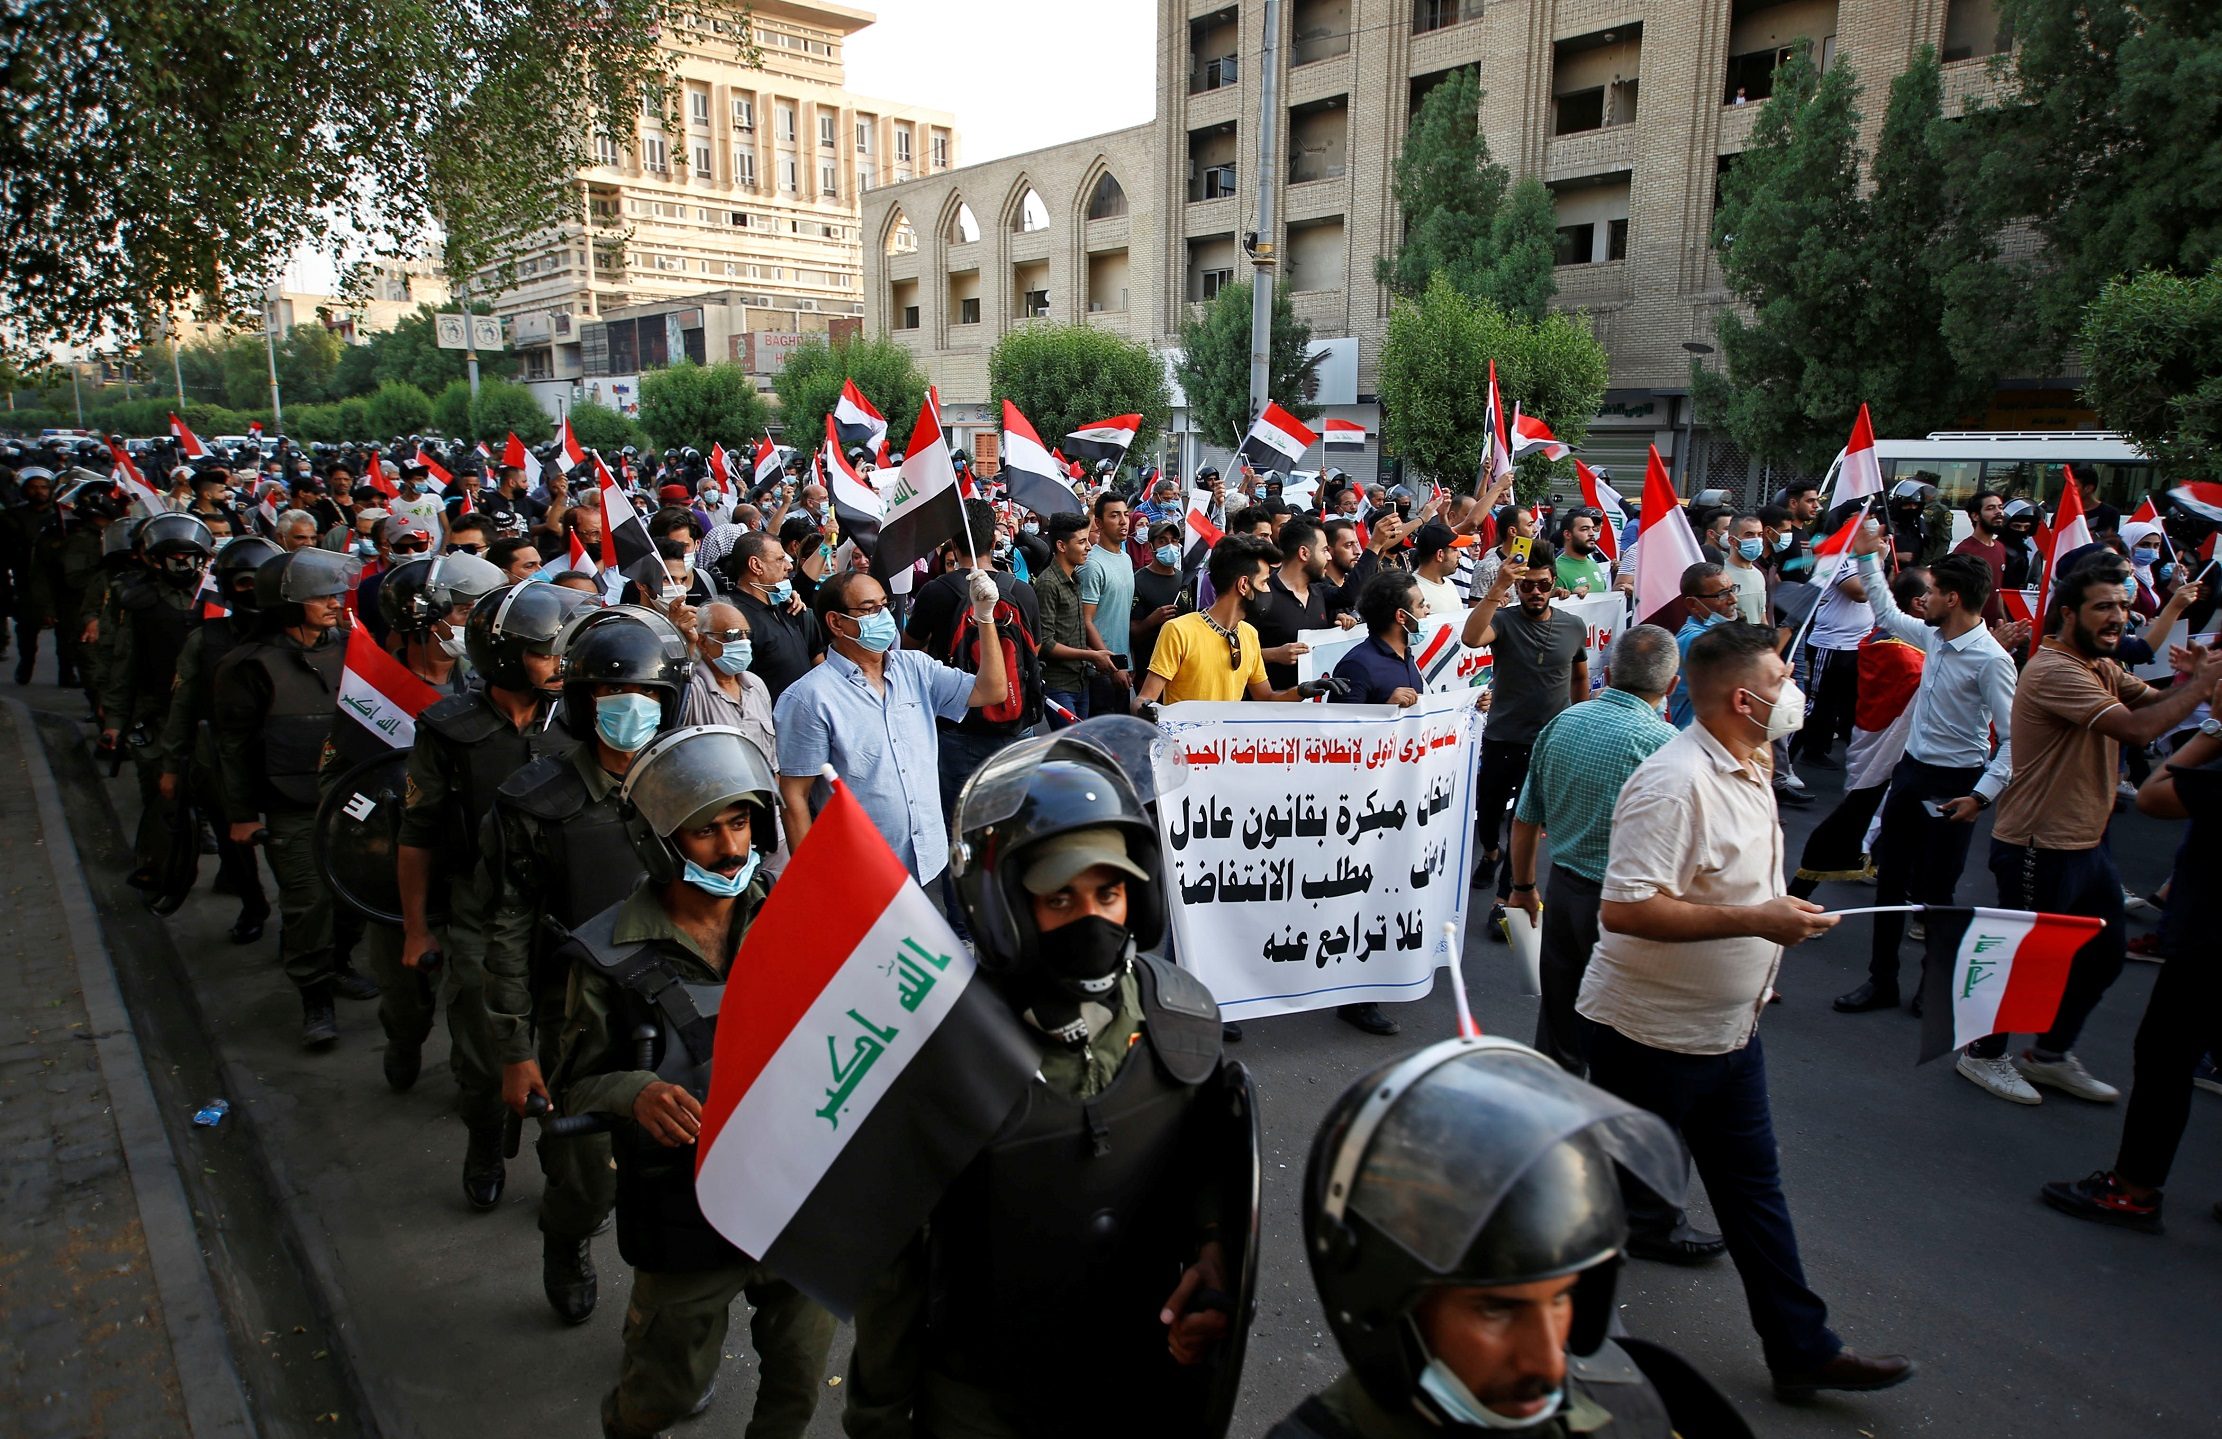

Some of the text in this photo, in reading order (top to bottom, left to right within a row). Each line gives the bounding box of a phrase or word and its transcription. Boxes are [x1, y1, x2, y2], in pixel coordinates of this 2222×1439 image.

[1169, 795, 1234, 851] عادل
[1242, 793, 1328, 850] بقانون
[1336, 789, 1408, 846] مبكرة
[1174, 857, 1294, 906] الانتفاضة
[1301, 856, 1374, 909] مطلب
[1262, 908, 1424, 969] فلا تراجع عنه
[877, 936, 953, 1013] الله
